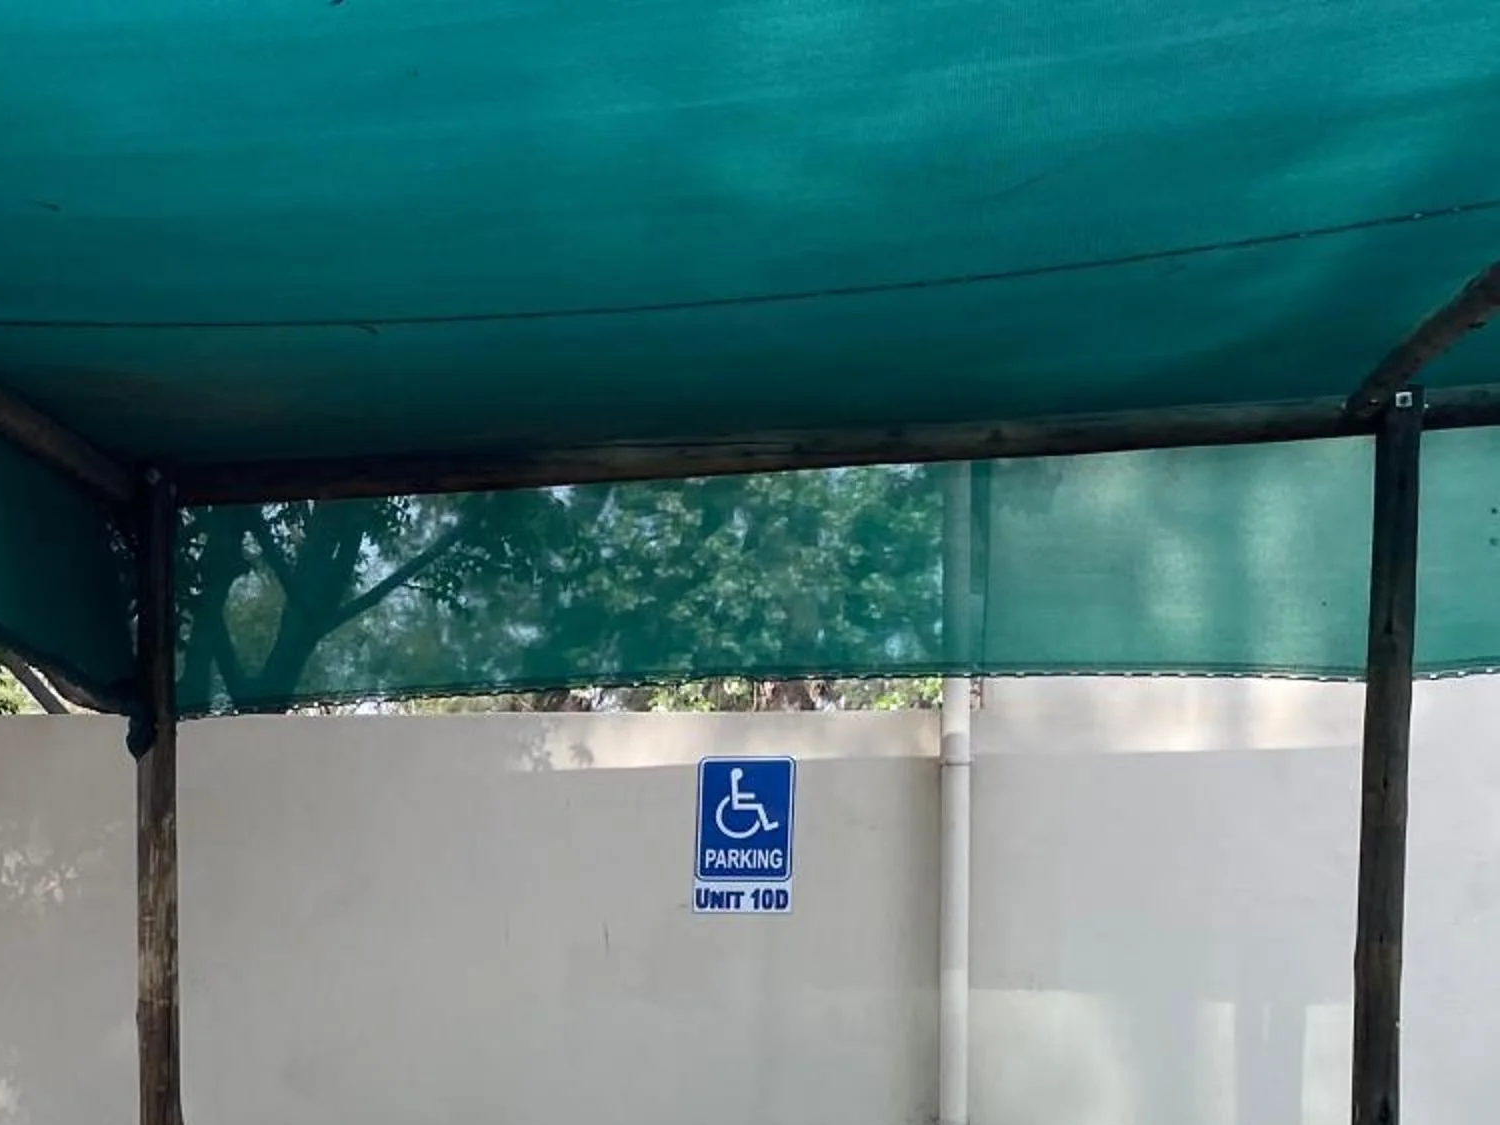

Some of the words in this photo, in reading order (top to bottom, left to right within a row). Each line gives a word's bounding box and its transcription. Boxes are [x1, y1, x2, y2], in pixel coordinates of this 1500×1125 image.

[705, 848, 783, 869] PARKING
[696, 888, 744, 909] UNIT
[750, 888, 789, 910] 10D
